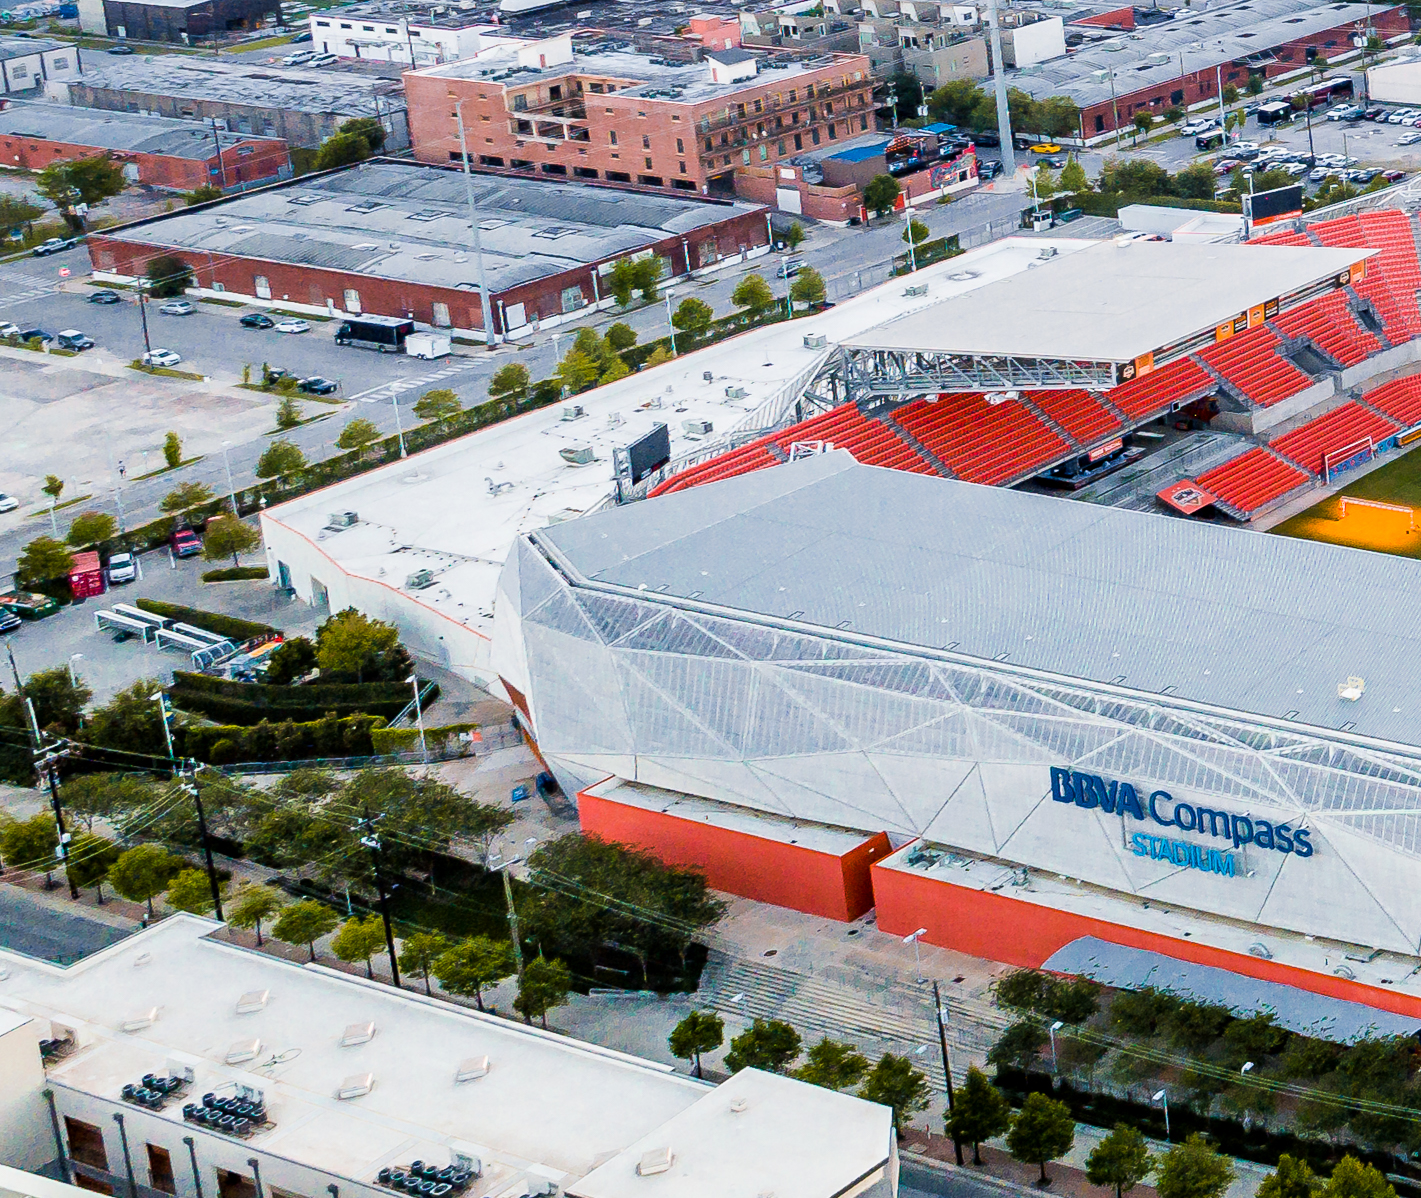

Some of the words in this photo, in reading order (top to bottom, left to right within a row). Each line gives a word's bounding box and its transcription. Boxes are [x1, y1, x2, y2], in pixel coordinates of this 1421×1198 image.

[1050, 766, 1145, 821] BBVA
[1148, 790, 1314, 858] Compass
[1132, 832, 1236, 878] STADIUM
